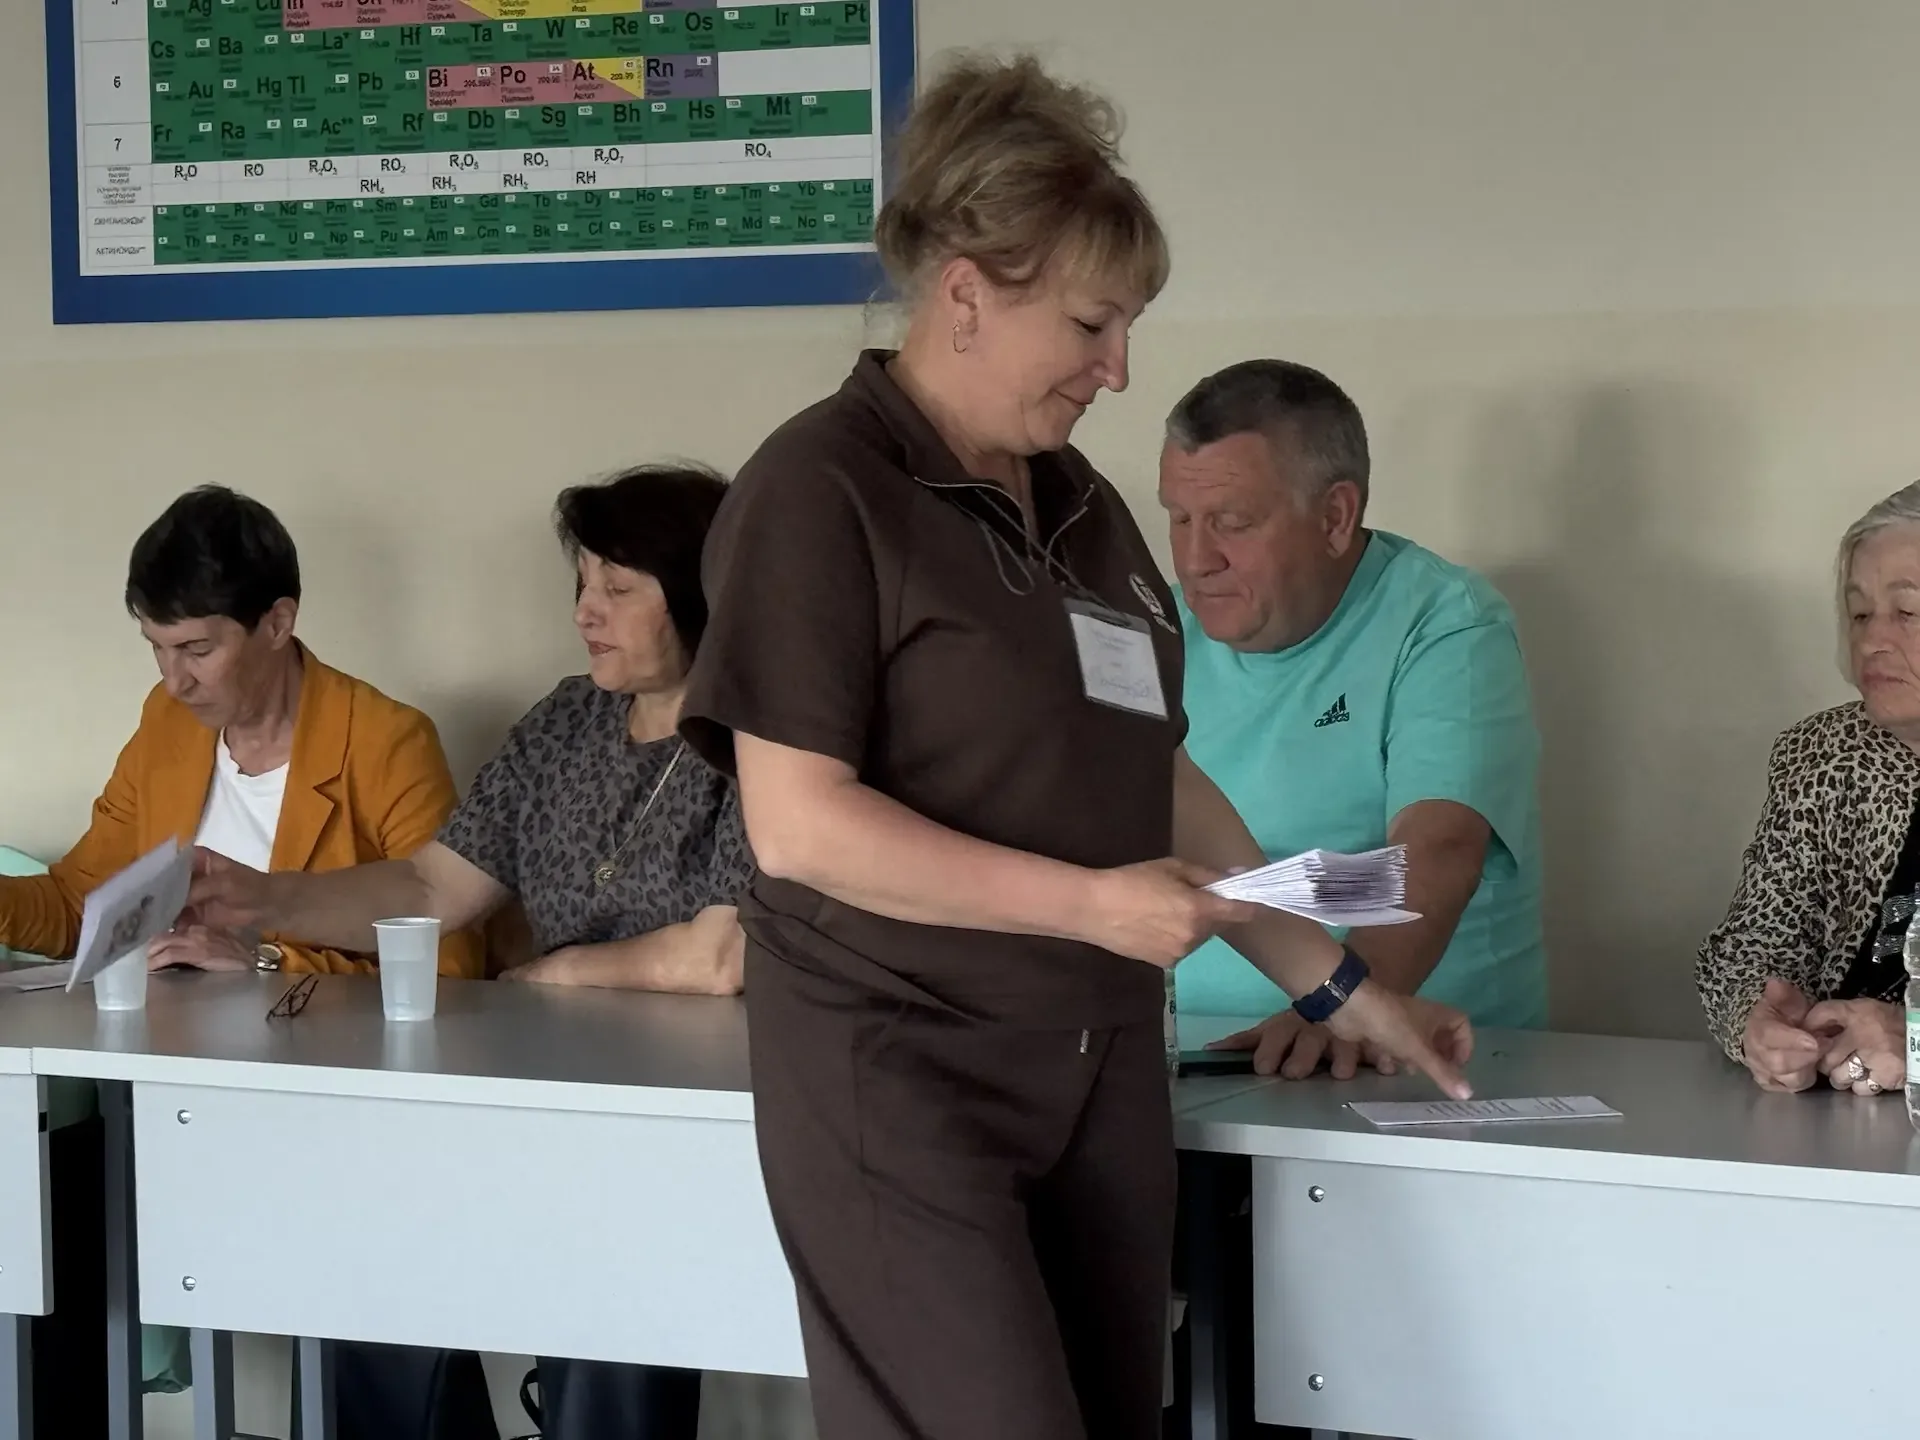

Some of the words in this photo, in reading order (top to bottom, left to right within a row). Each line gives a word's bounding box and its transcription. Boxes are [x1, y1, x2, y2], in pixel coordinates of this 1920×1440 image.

[188, 0, 212, 17] Ag
[775, 7, 789, 26] Ir
[844, 3, 867, 23] Pt
[546, 19, 565, 39] W
[612, 16, 638, 35] Re
[685, 12, 713, 32] Os
[401, 26, 422, 45] Hf
[470, 24, 492, 42] Ta
[151, 41, 175, 58] Cs
[218, 37, 243, 55] Ba
[500, 65, 526, 85] Po
[573, 62, 595, 81] At
[647, 58, 673, 77] Rn
[114, 76, 121, 88] 6
[287, 76, 305, 94] Tl
[358, 73, 383, 91] Pb
[429, 68, 448, 88] Bi
[188, 81, 213, 99] Au
[257, 77, 282, 97] Hg
[613, 104, 640, 123] Bh
[688, 100, 715, 120] Hs
[766, 96, 792, 116] Mt
[403, 113, 424, 132] Rf
[468, 110, 494, 129] Db
[541, 107, 566, 128] Sg
[153, 125, 173, 142] Fr
[221, 122, 245, 139] Ra
[114, 138, 122, 151] 7
[244, 163, 264, 177] RO
[576, 171, 596, 184] RH
[636, 189, 655, 202] Ho
[740, 186, 761, 199] Tm
[798, 183, 816, 196] Yb
[326, 201, 346, 214] Pm
[375, 199, 397, 212] Sm
[430, 197, 447, 210] Eu
[480, 195, 498, 207] Gd
[533, 194, 550, 207] Tb
[585, 191, 600, 207] Dy
[280, 202, 297, 216] Nd
[638, 221, 656, 233] Es
[742, 216, 762, 229] Md
[797, 216, 816, 229] No
[232, 234, 249, 247] Pa
[289, 232, 298, 244] U
[330, 231, 348, 245] Np
[381, 230, 398, 242] Pu
[426, 228, 448, 242] Am
[477, 226, 499, 239] Cm
[1314, 711, 1349, 728] adidas
